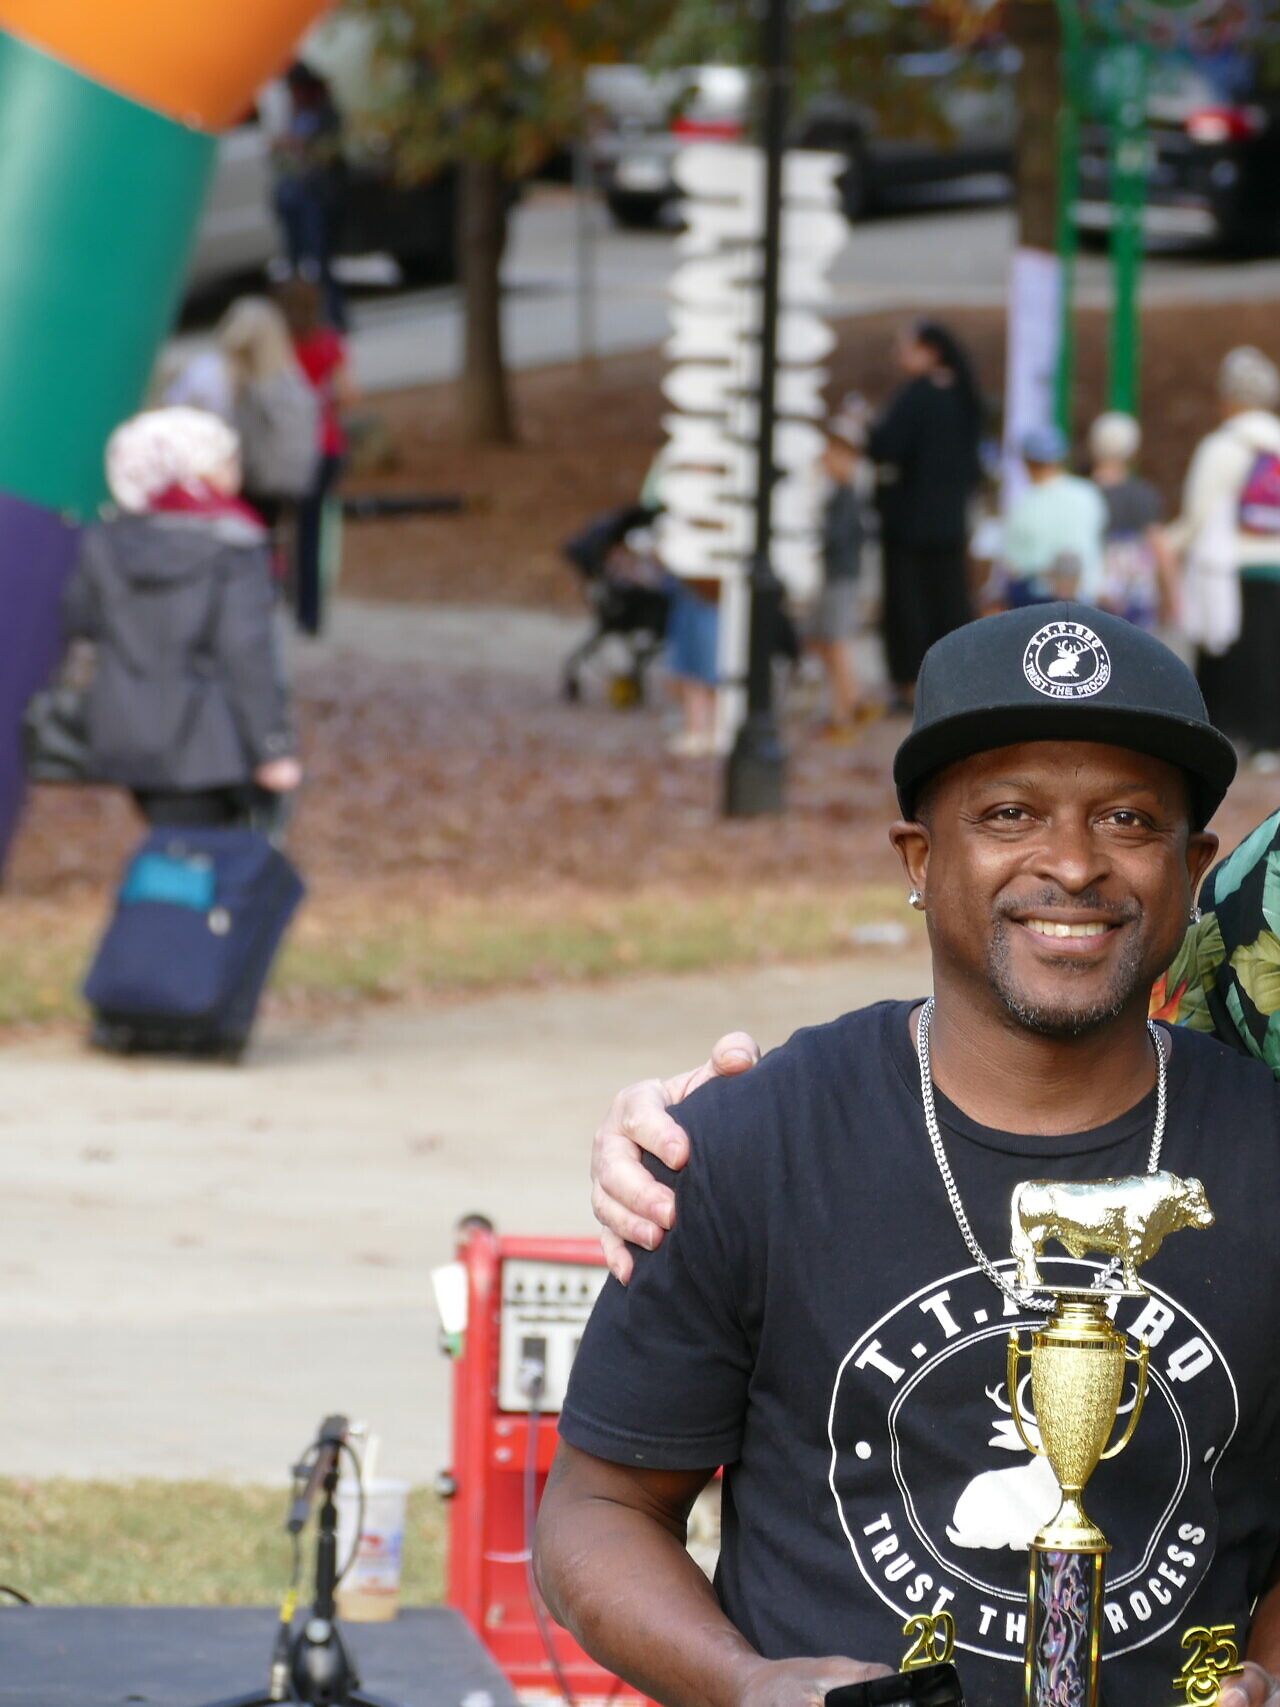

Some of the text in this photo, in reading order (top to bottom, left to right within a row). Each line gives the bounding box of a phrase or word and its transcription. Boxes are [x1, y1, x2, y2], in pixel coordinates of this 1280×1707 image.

[1025, 660, 1109, 696] TRUST THE PROCESS
[863, 1512, 1206, 1644] TRUST TH ROCESS
[902, 1611, 957, 1671] 20
[1181, 1624, 1239, 1677] 25
